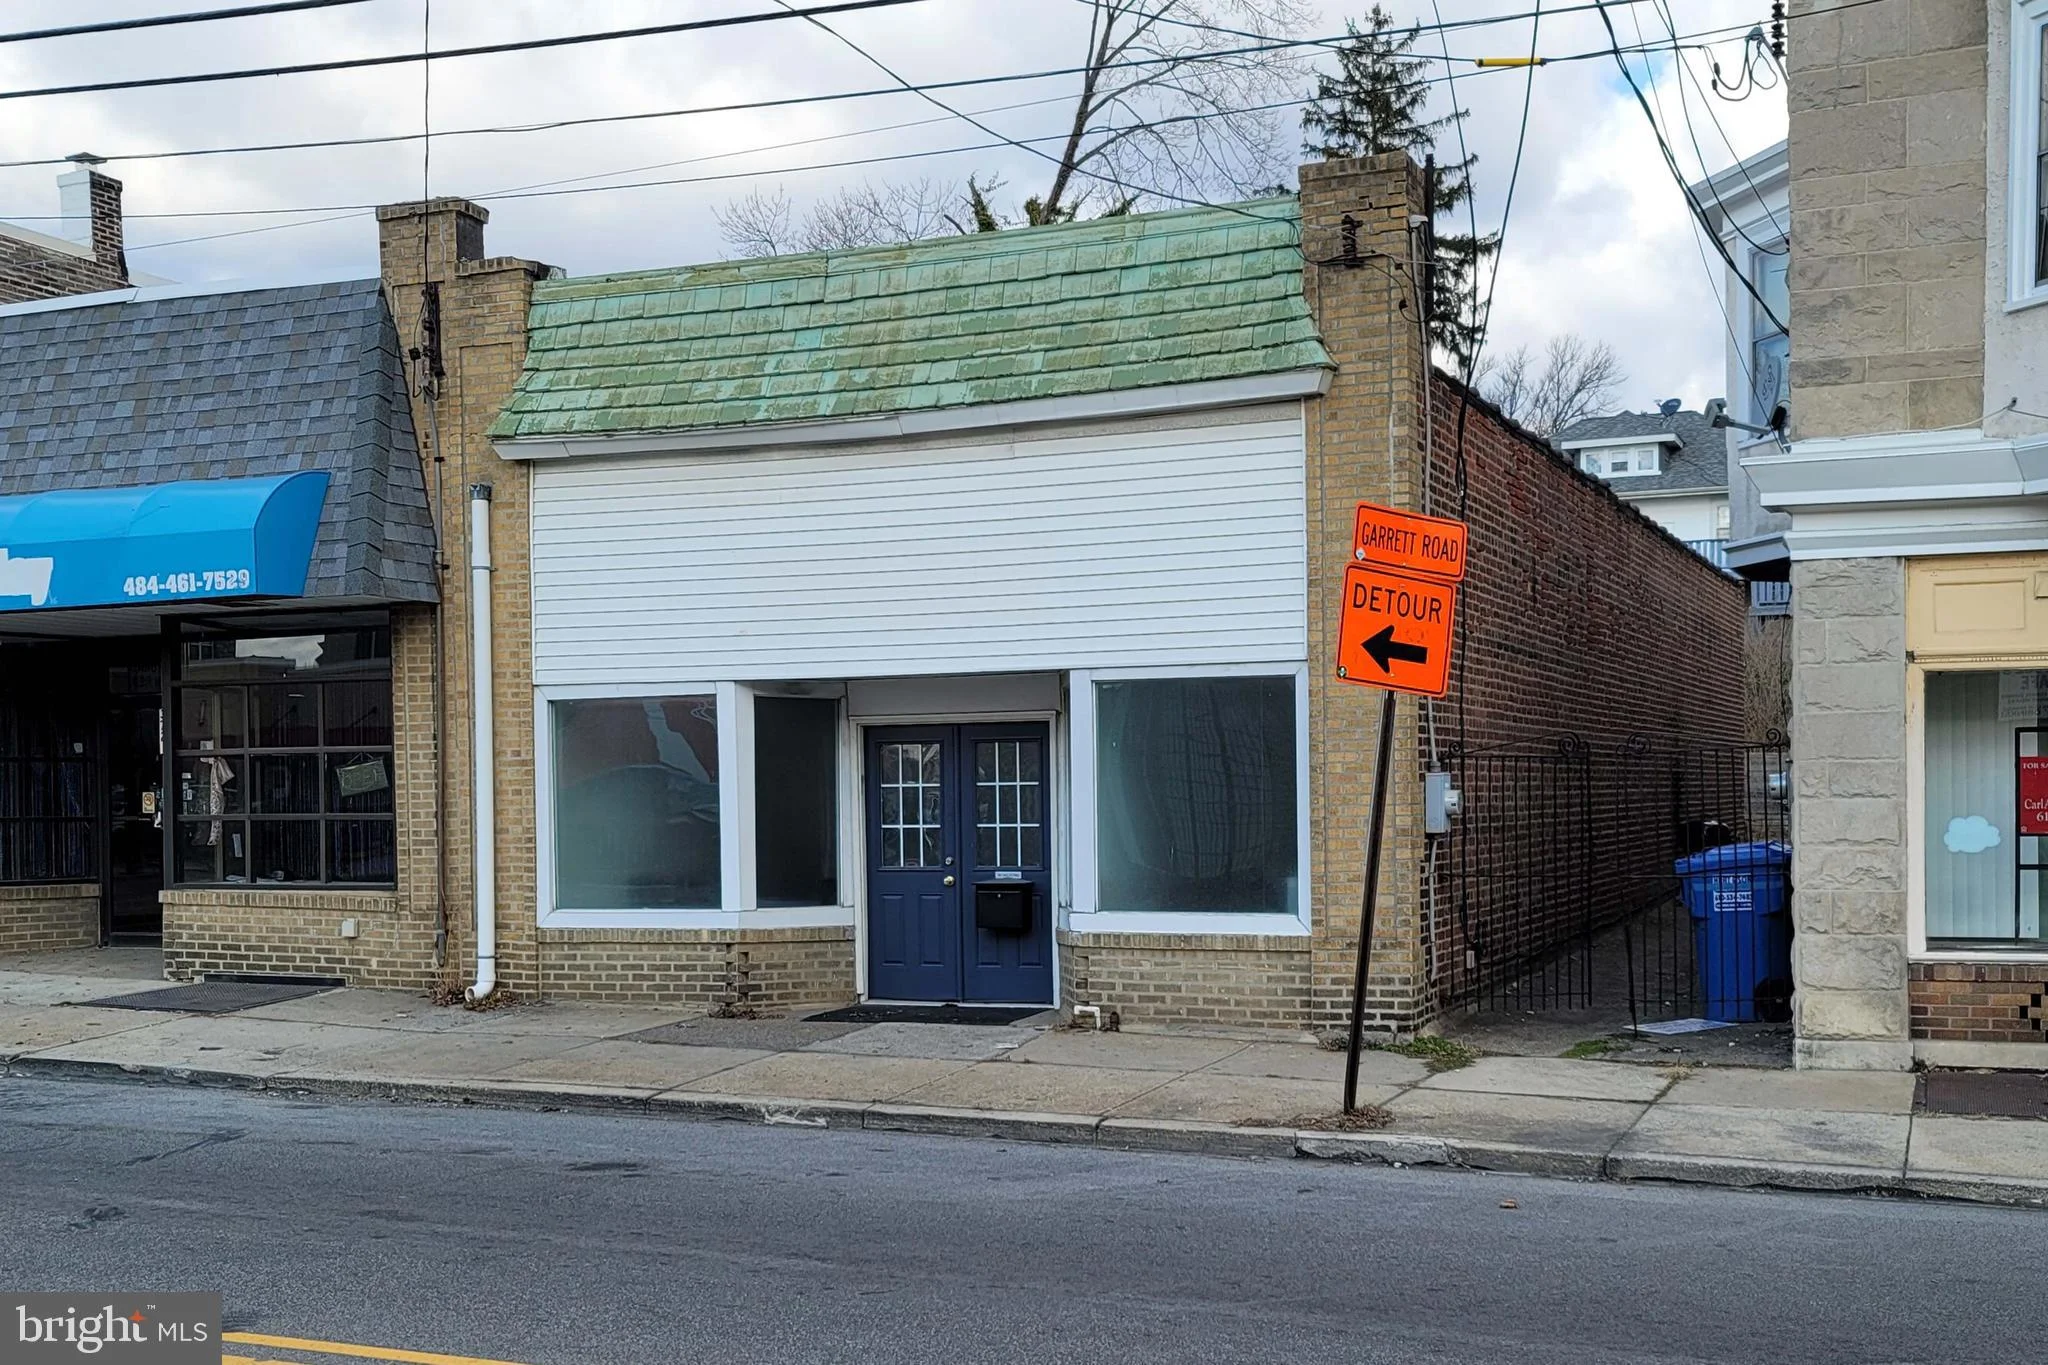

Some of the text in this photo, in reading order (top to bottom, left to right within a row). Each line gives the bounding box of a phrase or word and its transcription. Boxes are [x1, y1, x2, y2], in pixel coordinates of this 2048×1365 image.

[1361, 521, 1459, 563] GARRETT ROAD
[123, 569, 250, 596] 484-461-7529
[1352, 582, 1443, 624] DETOUR
